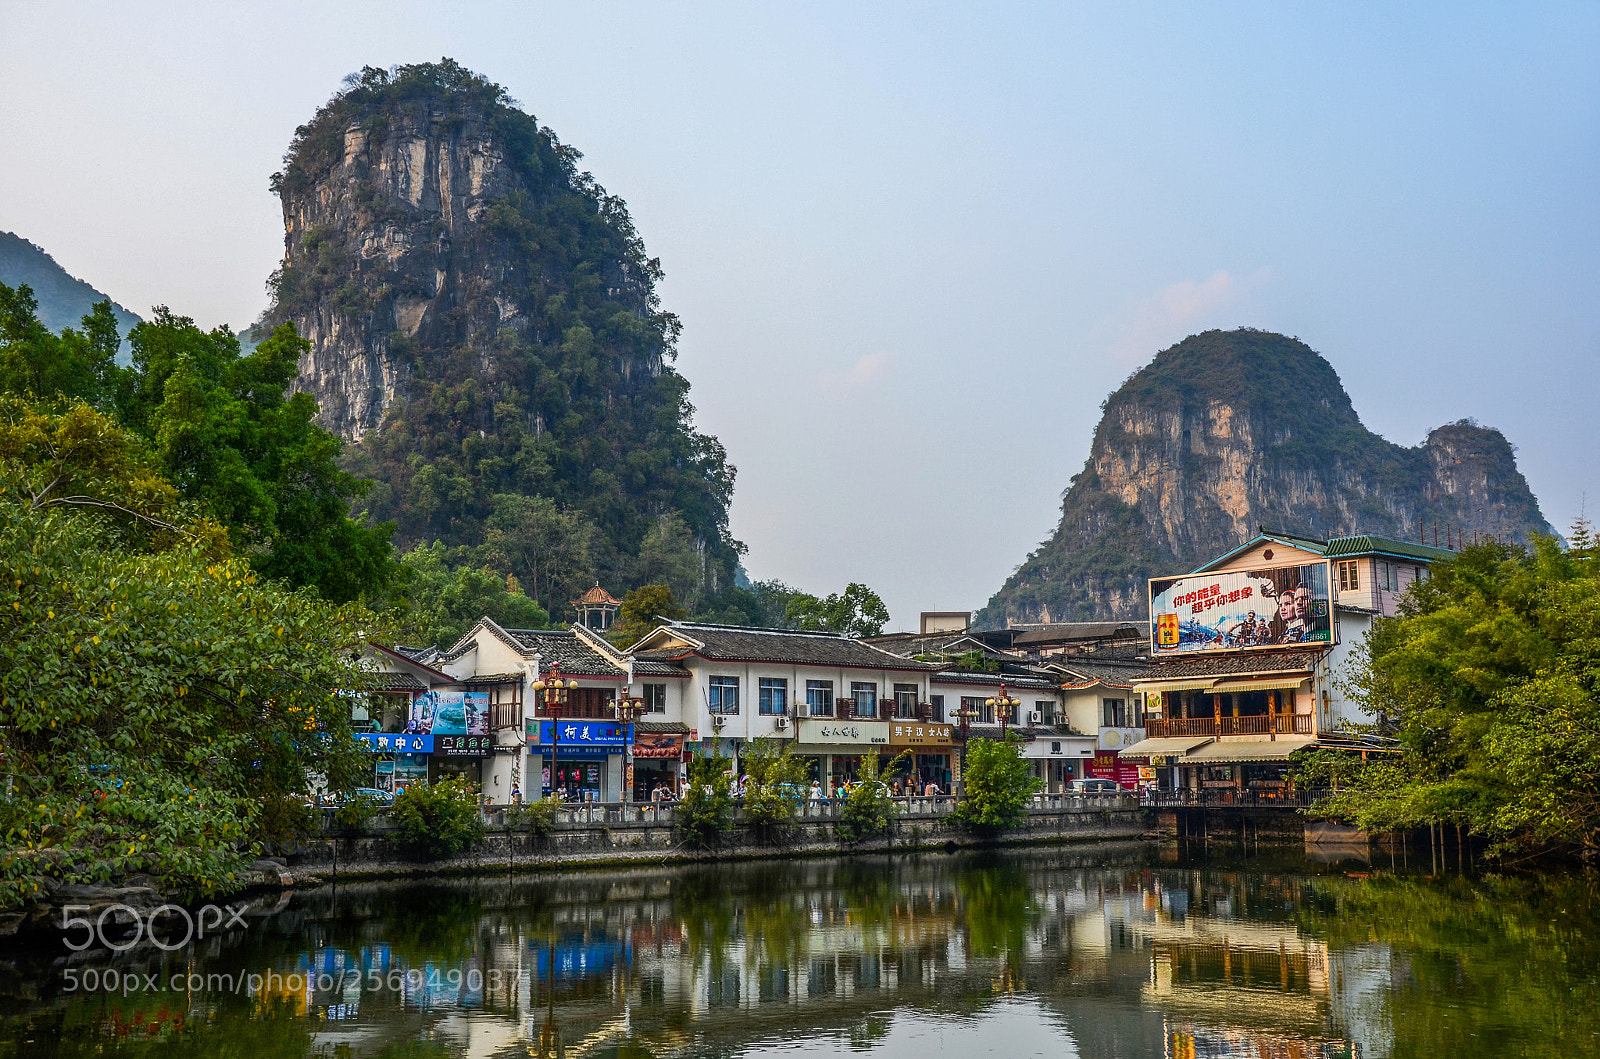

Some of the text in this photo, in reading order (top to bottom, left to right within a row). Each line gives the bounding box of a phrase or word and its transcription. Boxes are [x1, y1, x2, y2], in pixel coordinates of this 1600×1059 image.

[1173, 583, 1221, 608] 你的能量
[1191, 586, 1253, 614] 超乎你想象
[564, 724, 592, 741] 柯美
[895, 726, 924, 737] 男子汉
[360, 736, 424, 750] 散中心
